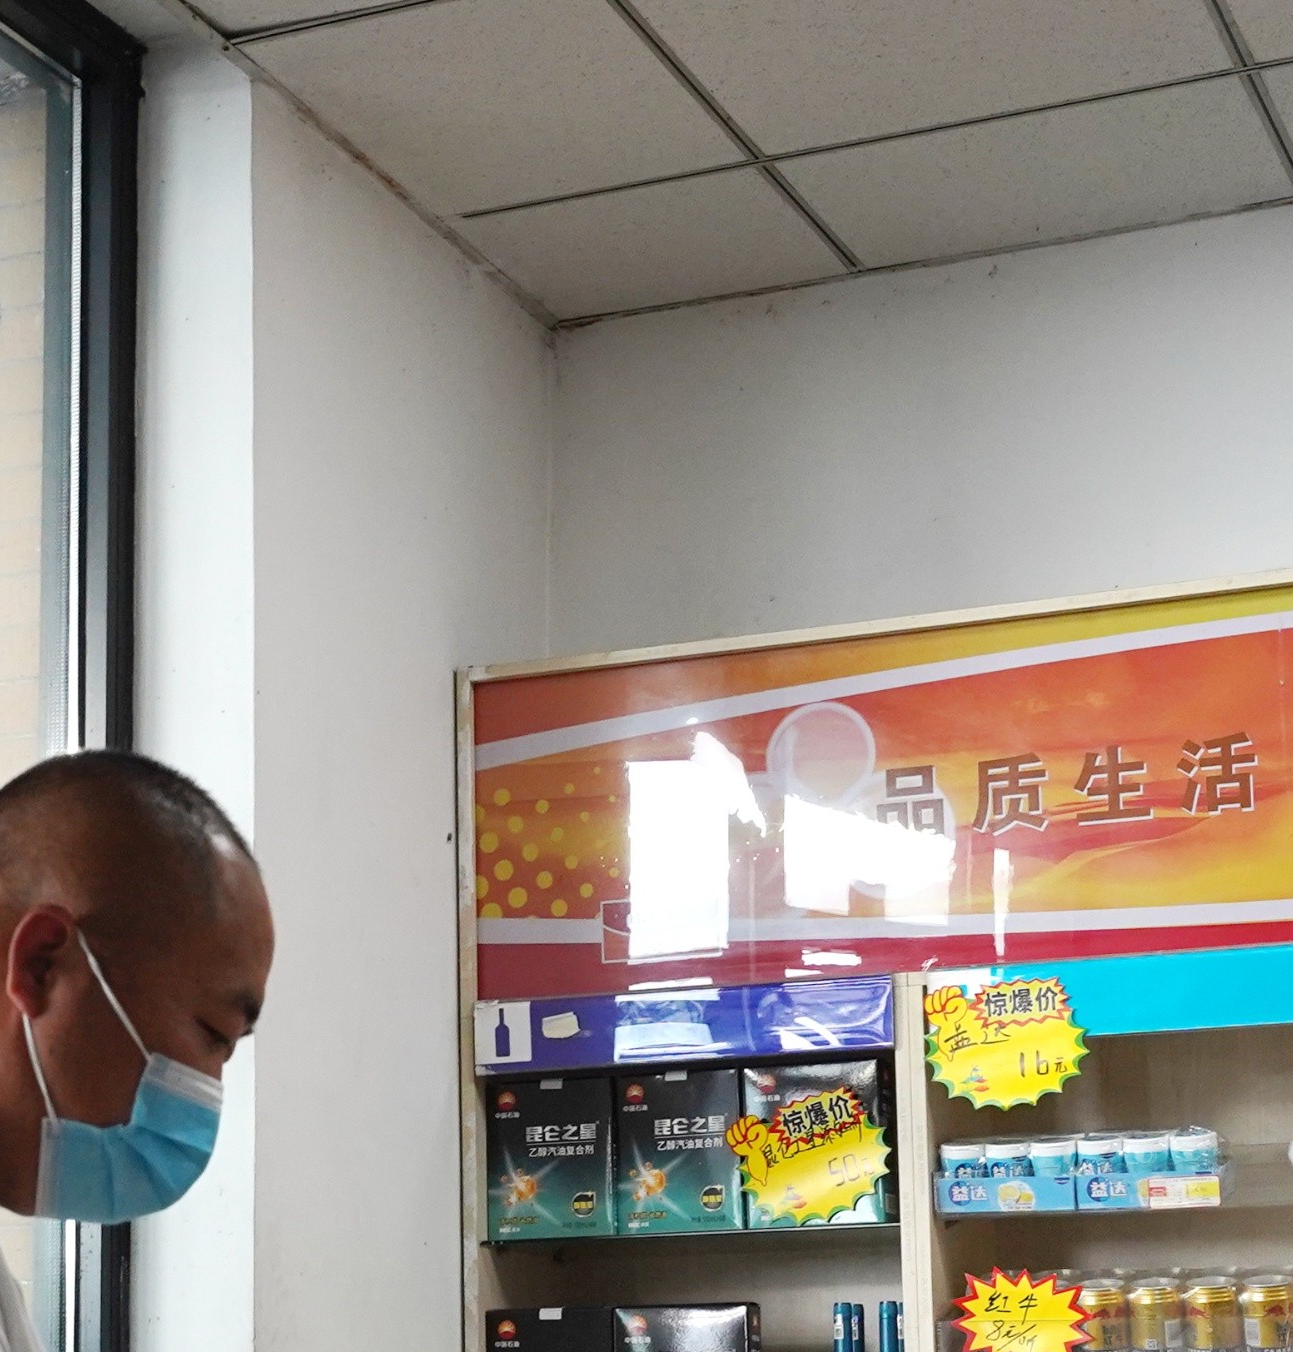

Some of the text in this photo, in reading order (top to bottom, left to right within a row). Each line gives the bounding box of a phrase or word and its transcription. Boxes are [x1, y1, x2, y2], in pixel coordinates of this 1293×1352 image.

[876, 731, 1258, 838] 品质生活
[985, 986, 1058, 1018] 惊爆价
[653, 1114, 726, 1136] 昆仑之星
[782, 1094, 854, 1137] 惊爆价
[525, 1122, 598, 1143] 昆仑之星
[528, 1144, 596, 1158] 乙醇汽油复合剂
[656, 1136, 724, 1151] 乙醇汽油复合剂
[951, 1184, 988, 1202] 益达
[1090, 1180, 1127, 1198] 益达
[984, 1290, 1039, 1326] 红牛
